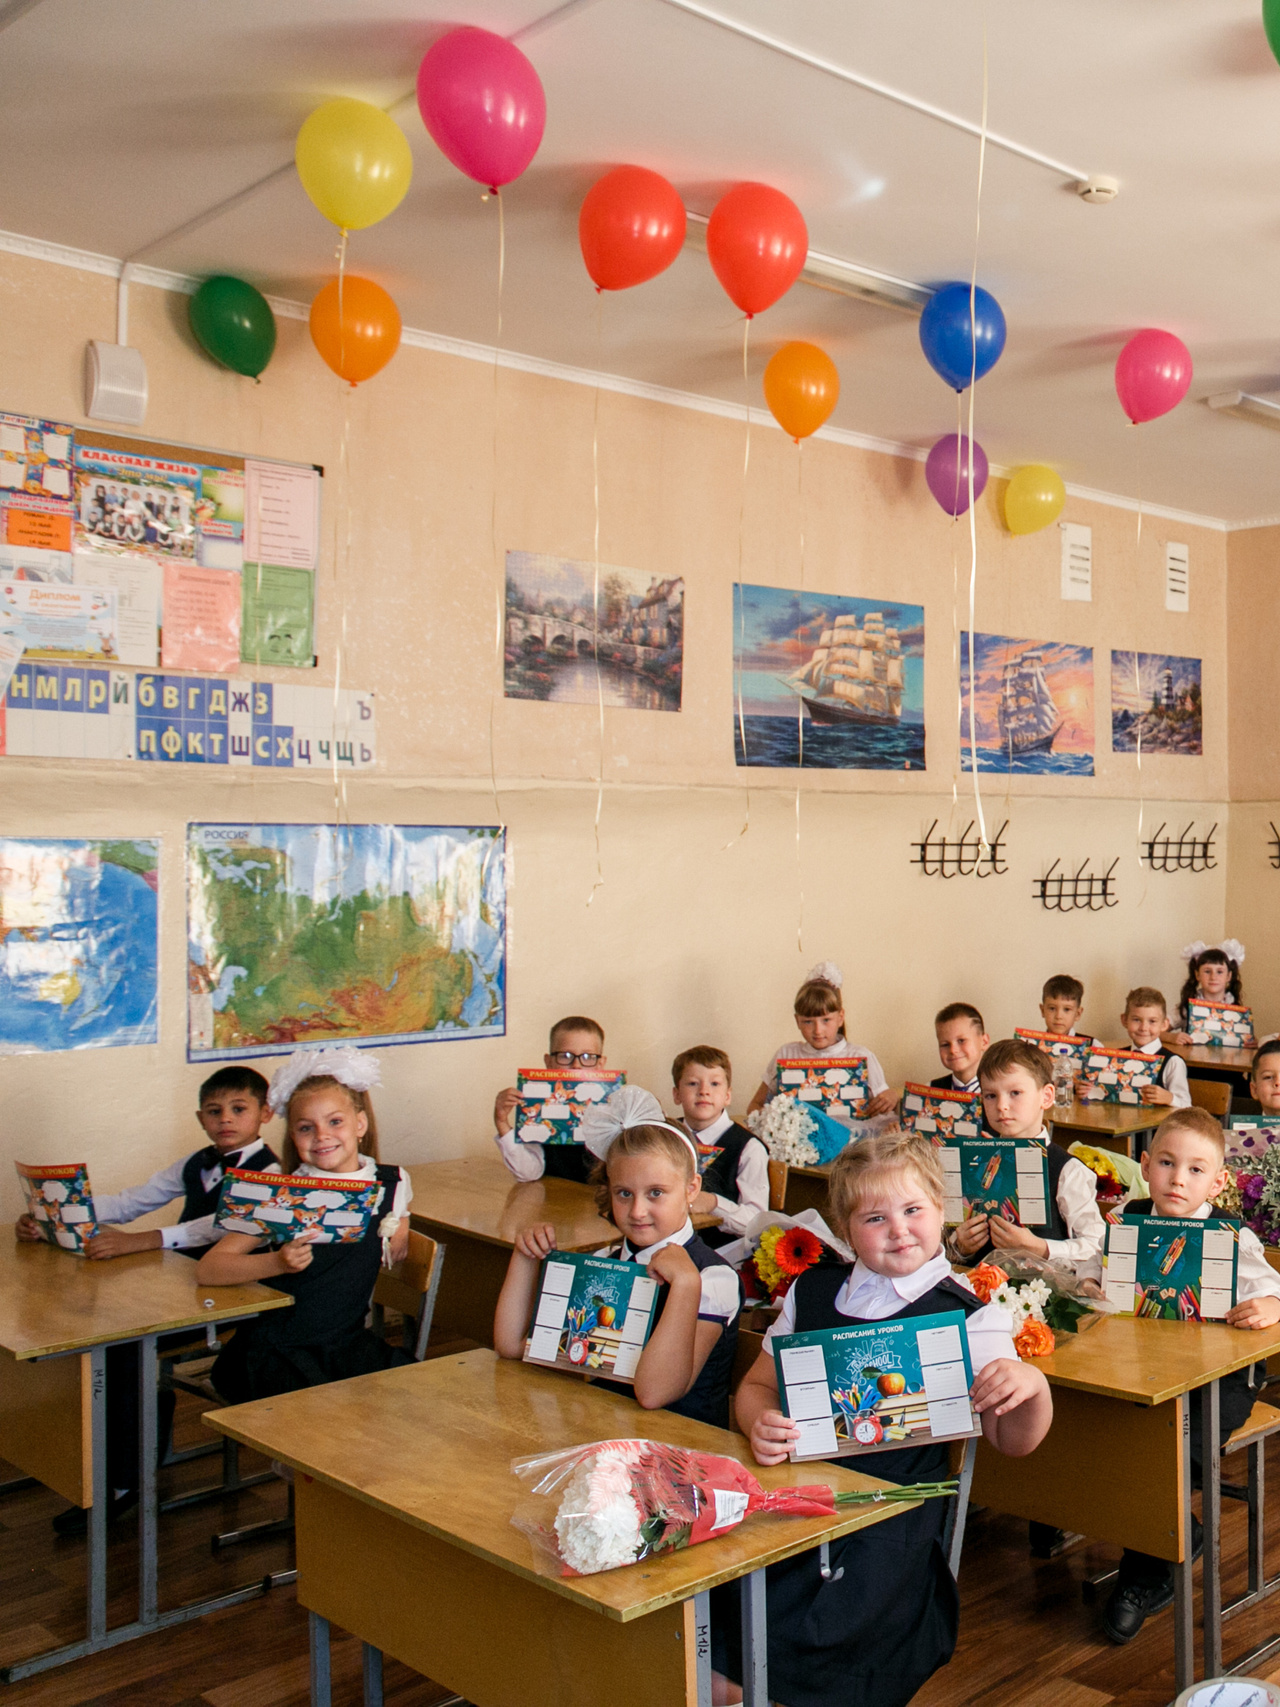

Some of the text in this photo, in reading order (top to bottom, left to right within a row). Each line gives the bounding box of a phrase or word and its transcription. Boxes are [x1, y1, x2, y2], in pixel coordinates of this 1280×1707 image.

[82, 450, 198, 476] КЛАССНАЯ ЖИЗНЬ
[29, 588, 81, 601] Диплом
[204, 830, 249, 839] РОССИЯ
[244, 1172, 366, 1189] РАСПИСАНИЕ УРОКОВ
[1144, 1219, 1181, 1227] РАСПИСАНИЕ
[584, 1259, 613, 1270] РАСПИСАНИЕ
[832, 1324, 904, 1341] РАСПИСАНИЕ УРОКОВ
